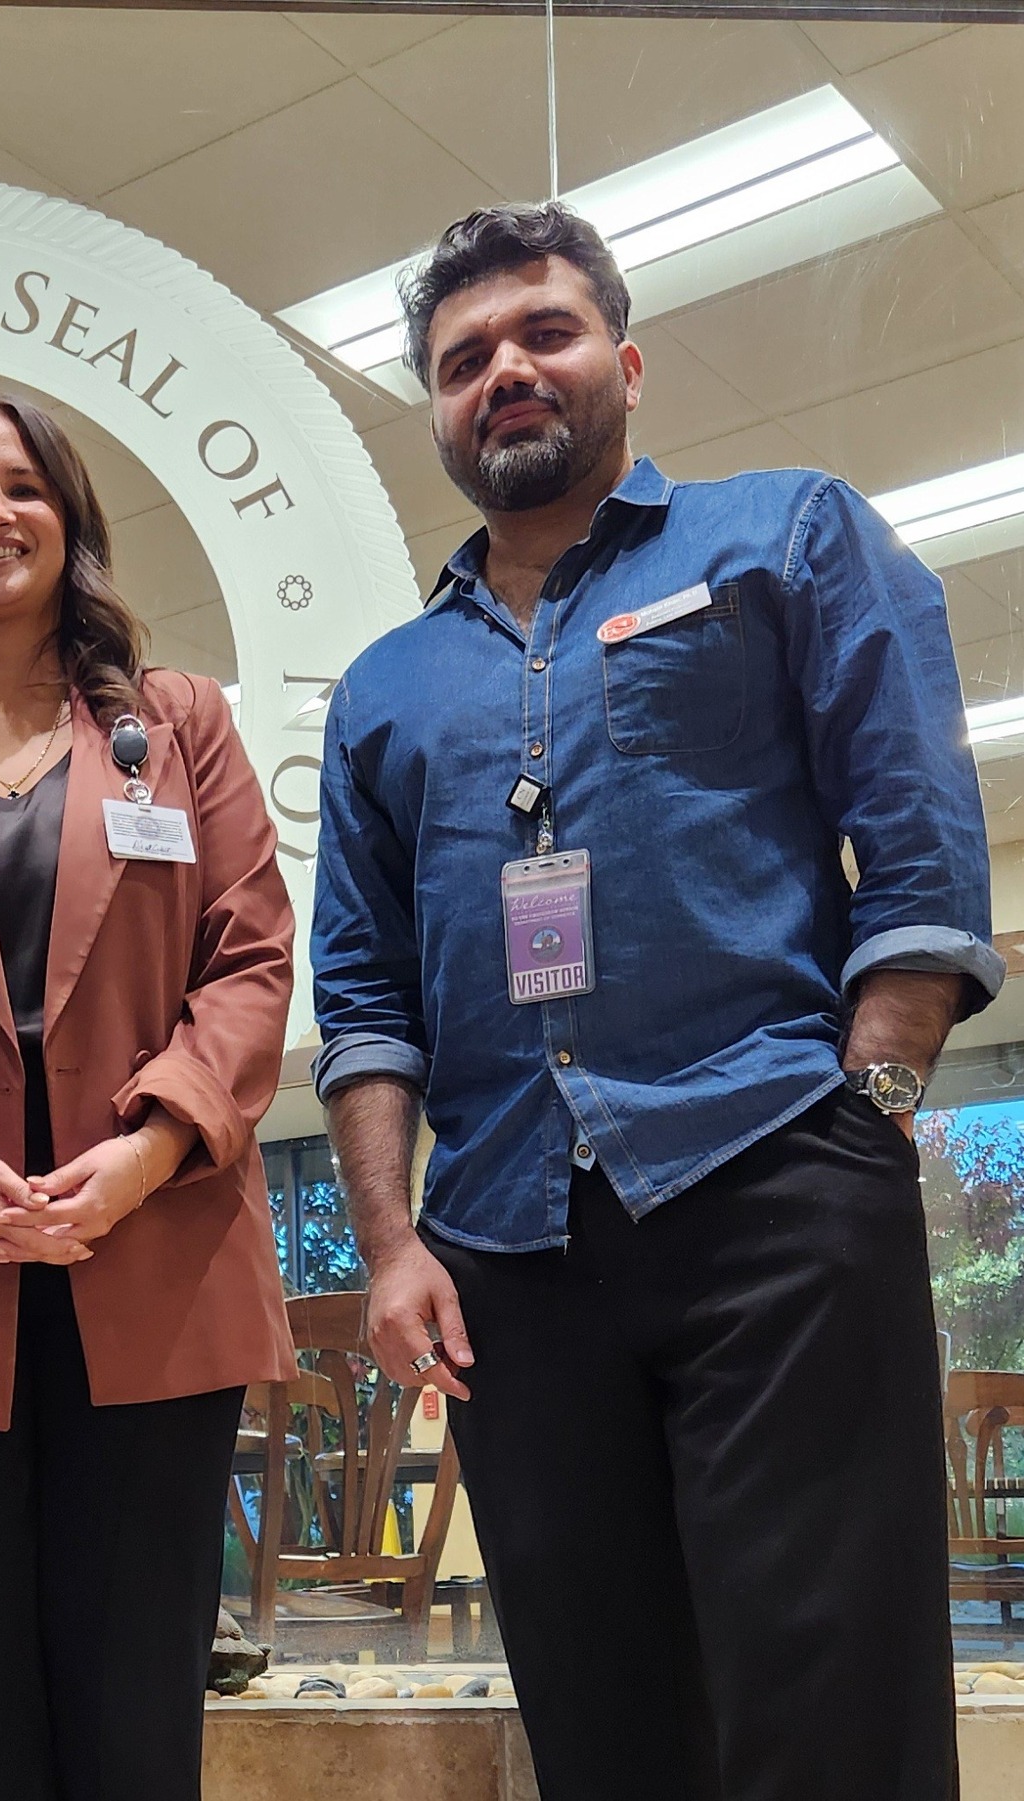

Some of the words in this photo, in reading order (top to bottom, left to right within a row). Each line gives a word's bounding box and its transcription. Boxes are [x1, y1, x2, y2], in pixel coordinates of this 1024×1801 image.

[0, 270, 188, 420] SEAL
[197, 419, 296, 521] OF
[516, 965, 585, 997] VISITOR
